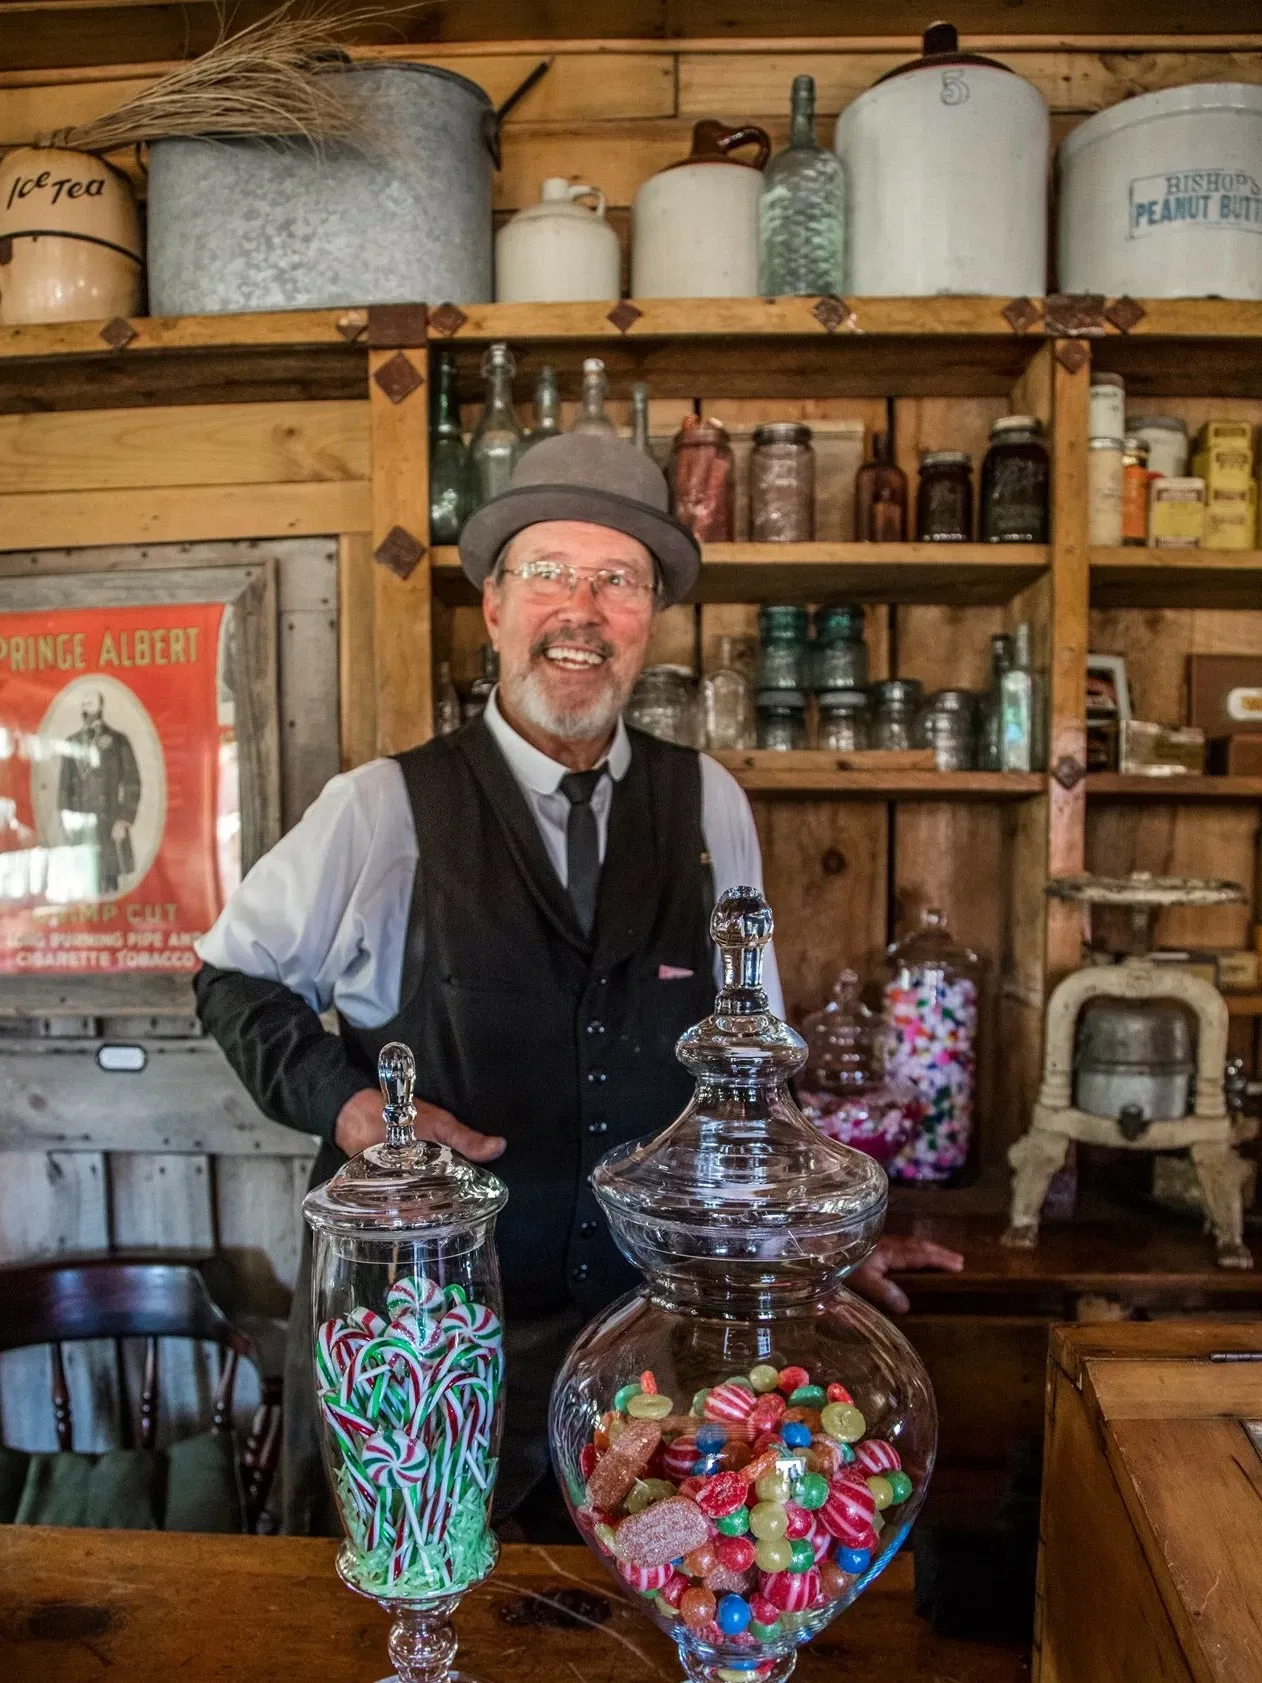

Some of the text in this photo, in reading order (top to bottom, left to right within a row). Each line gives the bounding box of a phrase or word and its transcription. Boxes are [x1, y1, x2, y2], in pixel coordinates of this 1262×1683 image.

[940, 68, 970, 106] 5
[1135, 194, 1212, 228] PEANUT
[98, 627, 199, 668] ALBERT
[126, 903, 178, 925] CUT
[115, 948, 195, 968] TOBACCO
